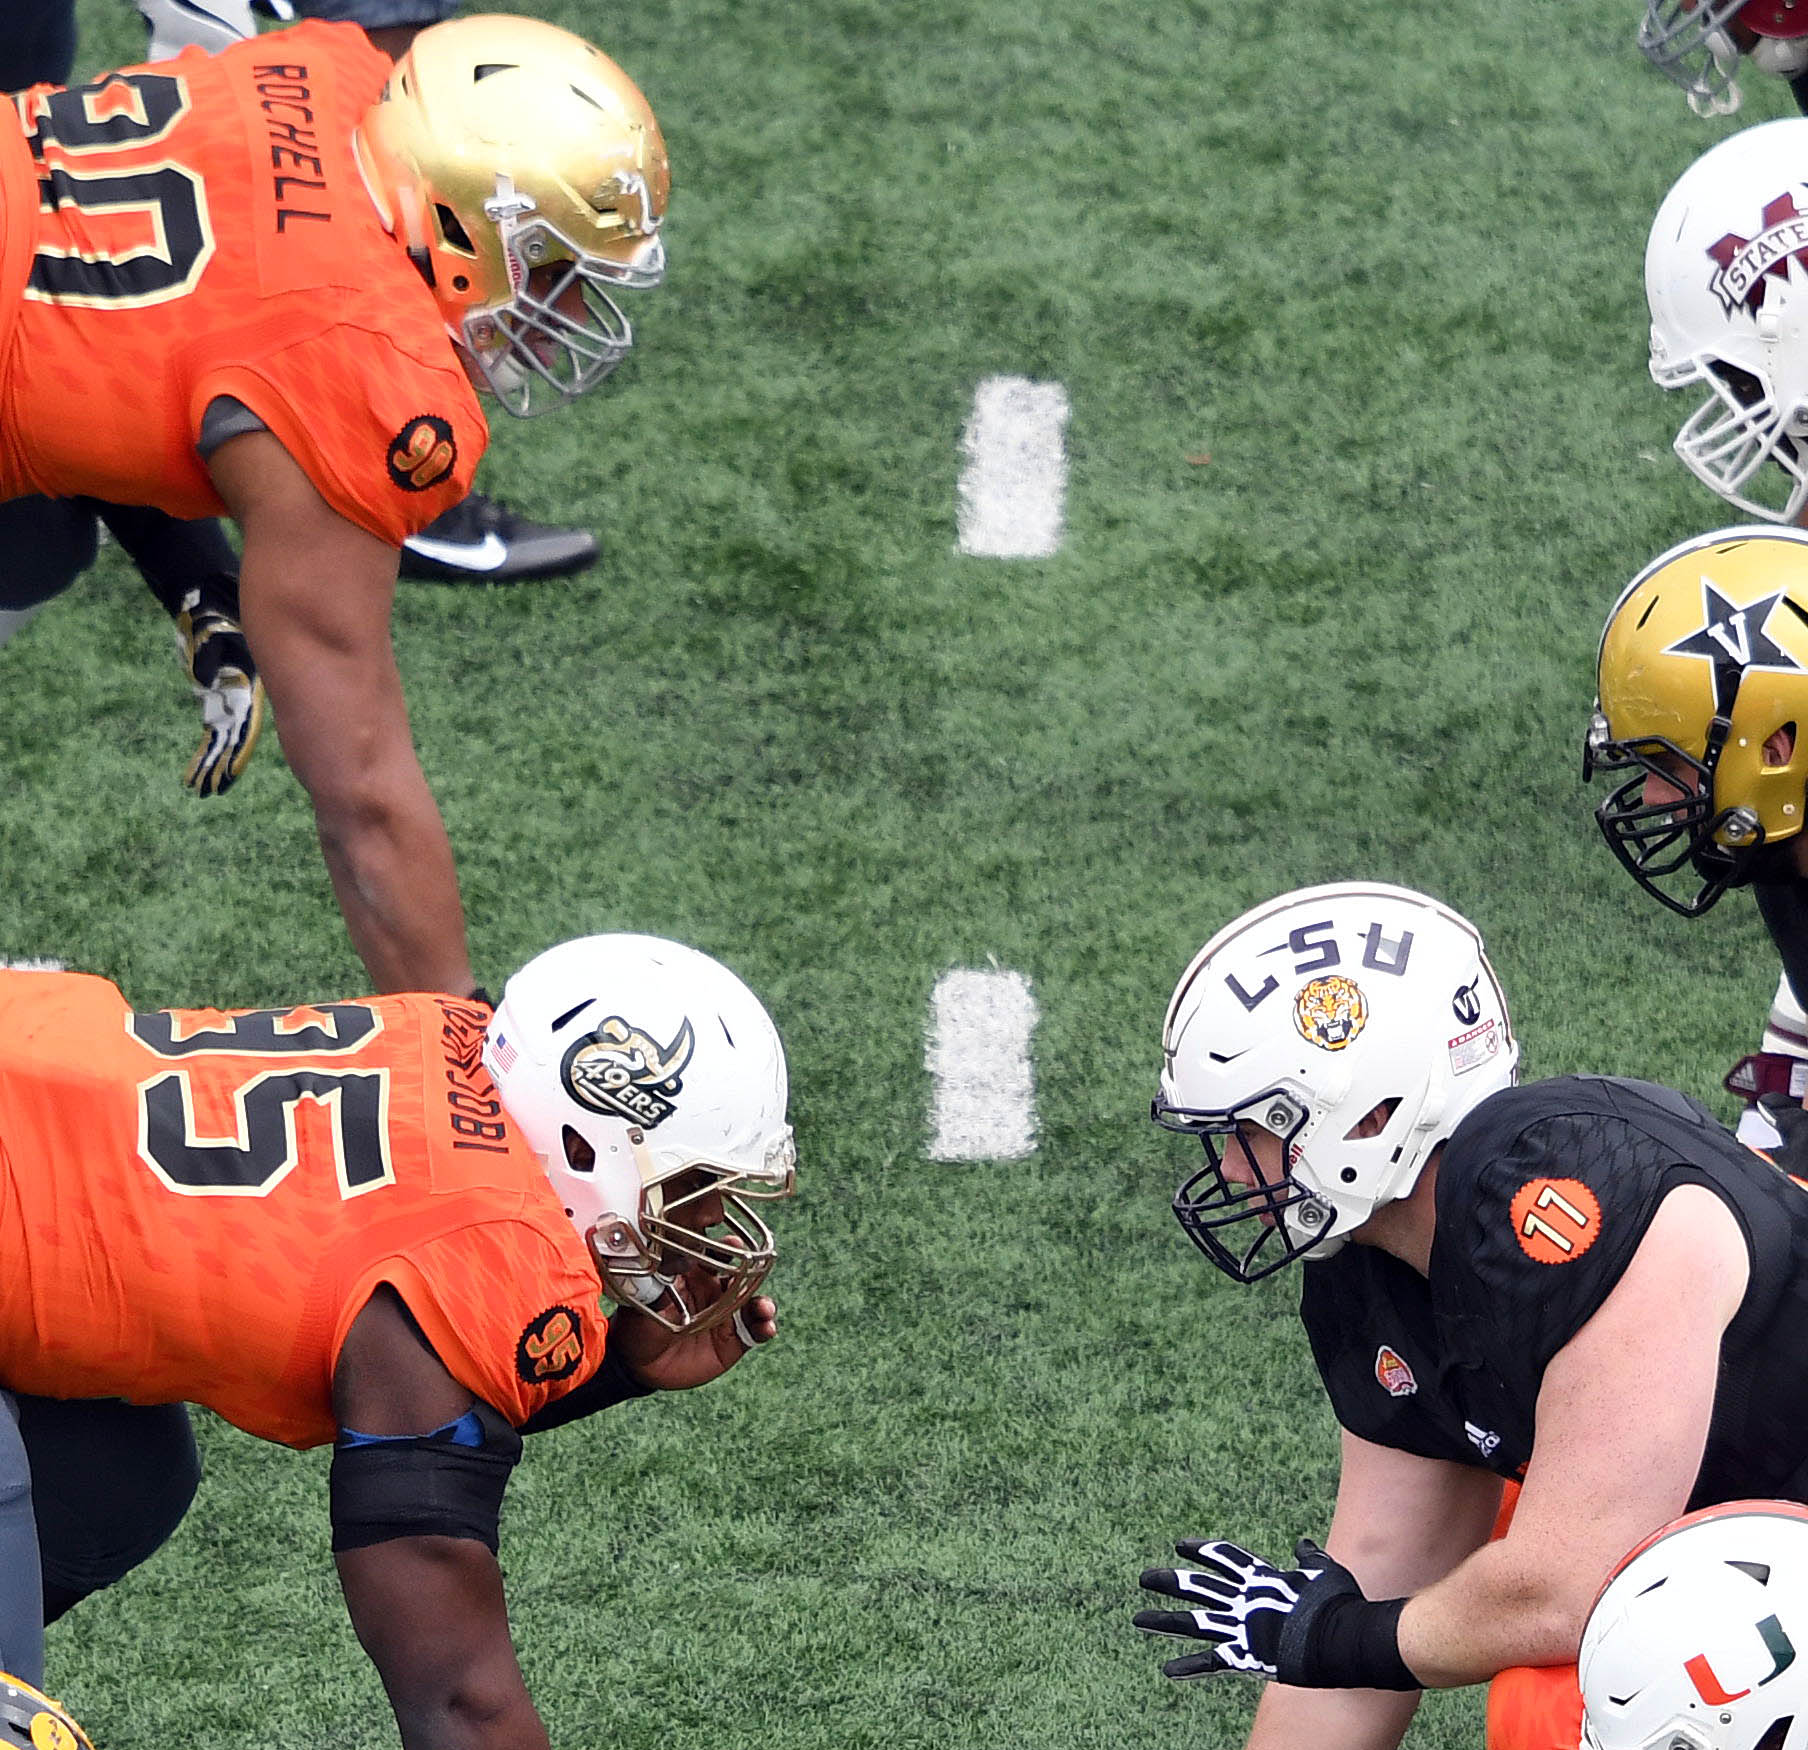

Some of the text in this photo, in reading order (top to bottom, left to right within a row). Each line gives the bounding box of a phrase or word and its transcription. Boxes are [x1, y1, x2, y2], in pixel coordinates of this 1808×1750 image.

[252, 64, 333, 235] ROCHELL
[392, 423, 454, 488] 90
[1706, 611, 1752, 666] V
[1224, 919, 1415, 1014] LSU
[575, 1058, 668, 1125] 49ERS
[1520, 1184, 1590, 1256] 77
[524, 1312, 582, 1377] 95
[1683, 1613, 1796, 1706] U
